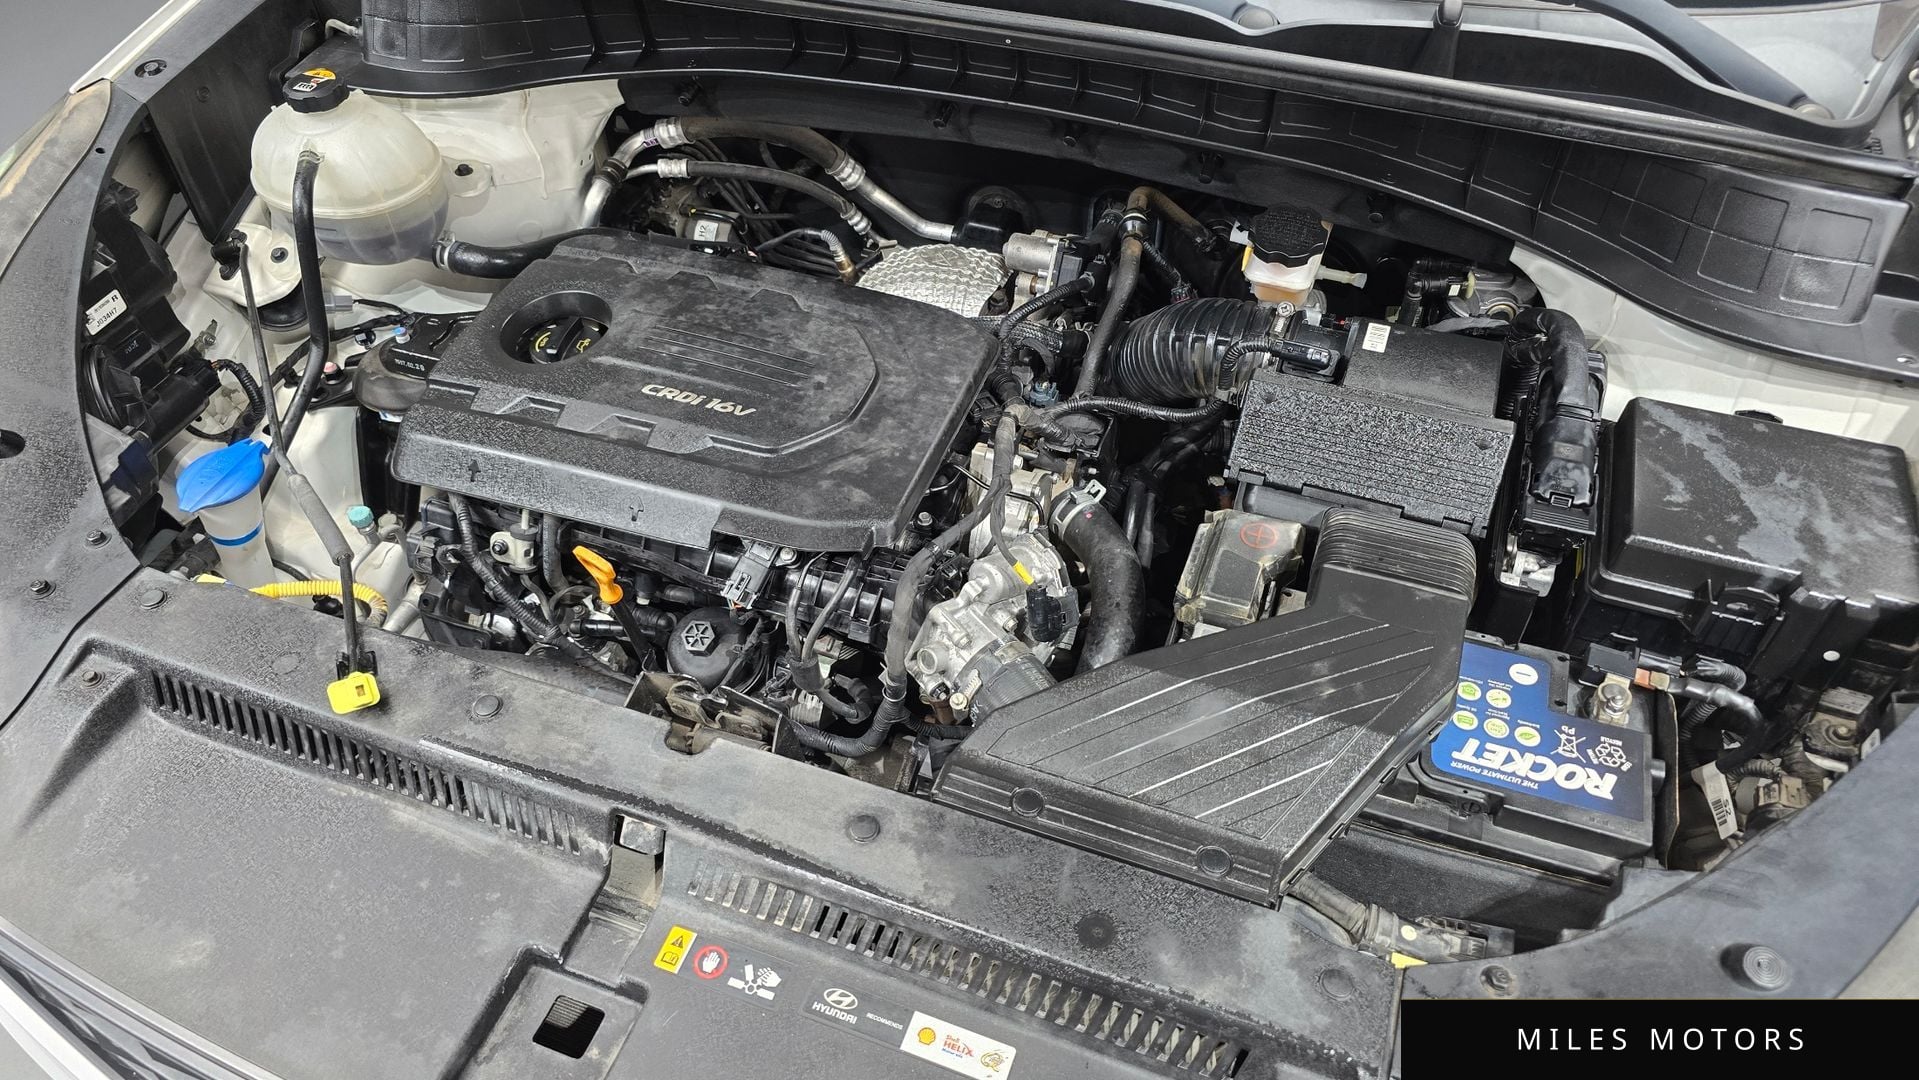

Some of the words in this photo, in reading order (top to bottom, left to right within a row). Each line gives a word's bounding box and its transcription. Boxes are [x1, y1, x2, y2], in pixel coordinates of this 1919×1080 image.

[111, 294, 119, 302] R
[641, 384, 706, 405] CRDi
[705, 398, 756, 416] 16V
[1561, 725, 1576, 735] Pb
[1450, 760, 1481, 776] POWER
[1451, 737, 1618, 800] ROCKET
[1481, 768, 1522, 786] ULTIMATE
[1521, 778, 1539, 790] THE
[812, 1001, 857, 1024] HYUNDAI
[866, 1012, 904, 1030] RECOMMENDS
[943, 1040, 974, 1057] HELIX
